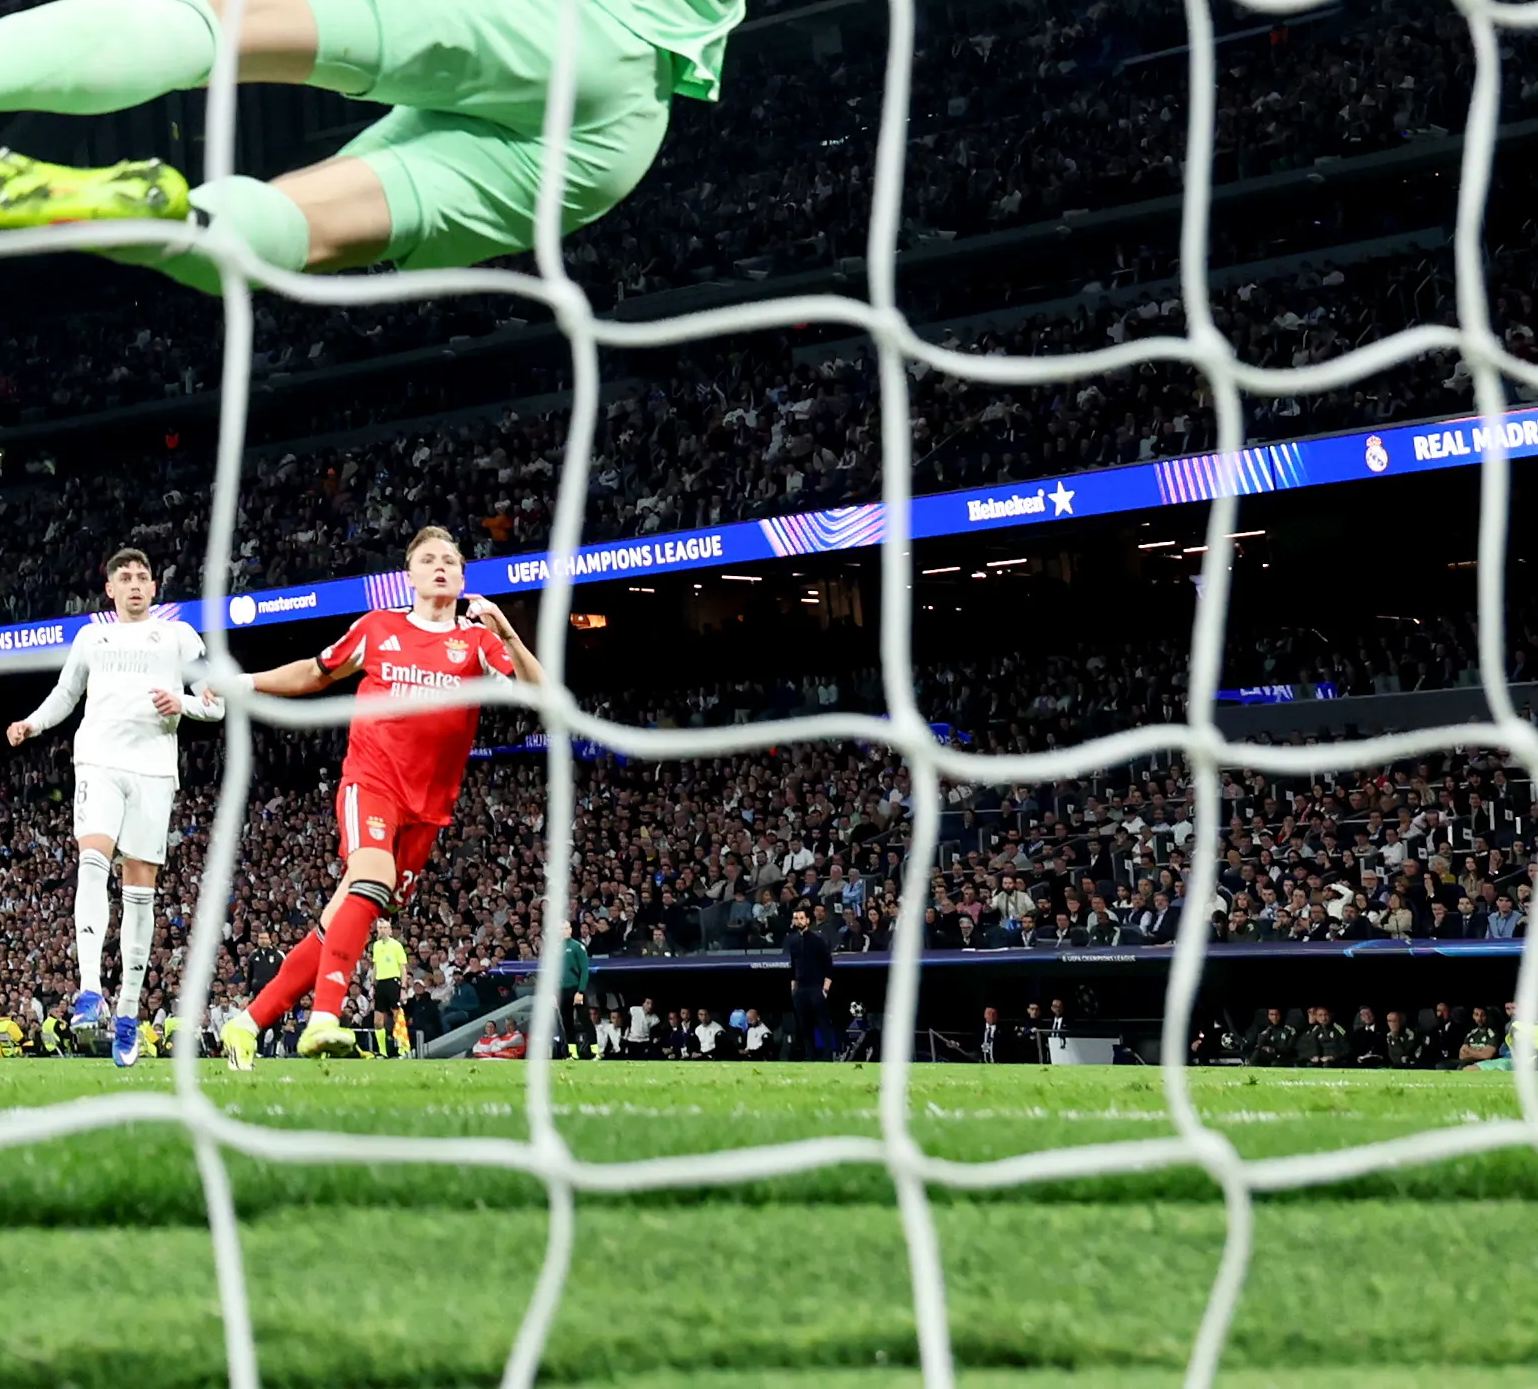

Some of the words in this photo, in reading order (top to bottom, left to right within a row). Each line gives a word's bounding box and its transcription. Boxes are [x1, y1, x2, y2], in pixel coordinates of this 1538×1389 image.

[1414, 434, 1471, 461] REAL
[967, 489, 1045, 522] Heineken
[507, 560, 551, 584] UEFA
[656, 535, 723, 567] LEAGUE
[258, 592, 317, 615] mastercard
[15, 624, 64, 649] LEAGUE
[380, 662, 462, 690] Emirates
[77, 780, 88, 805] 8
